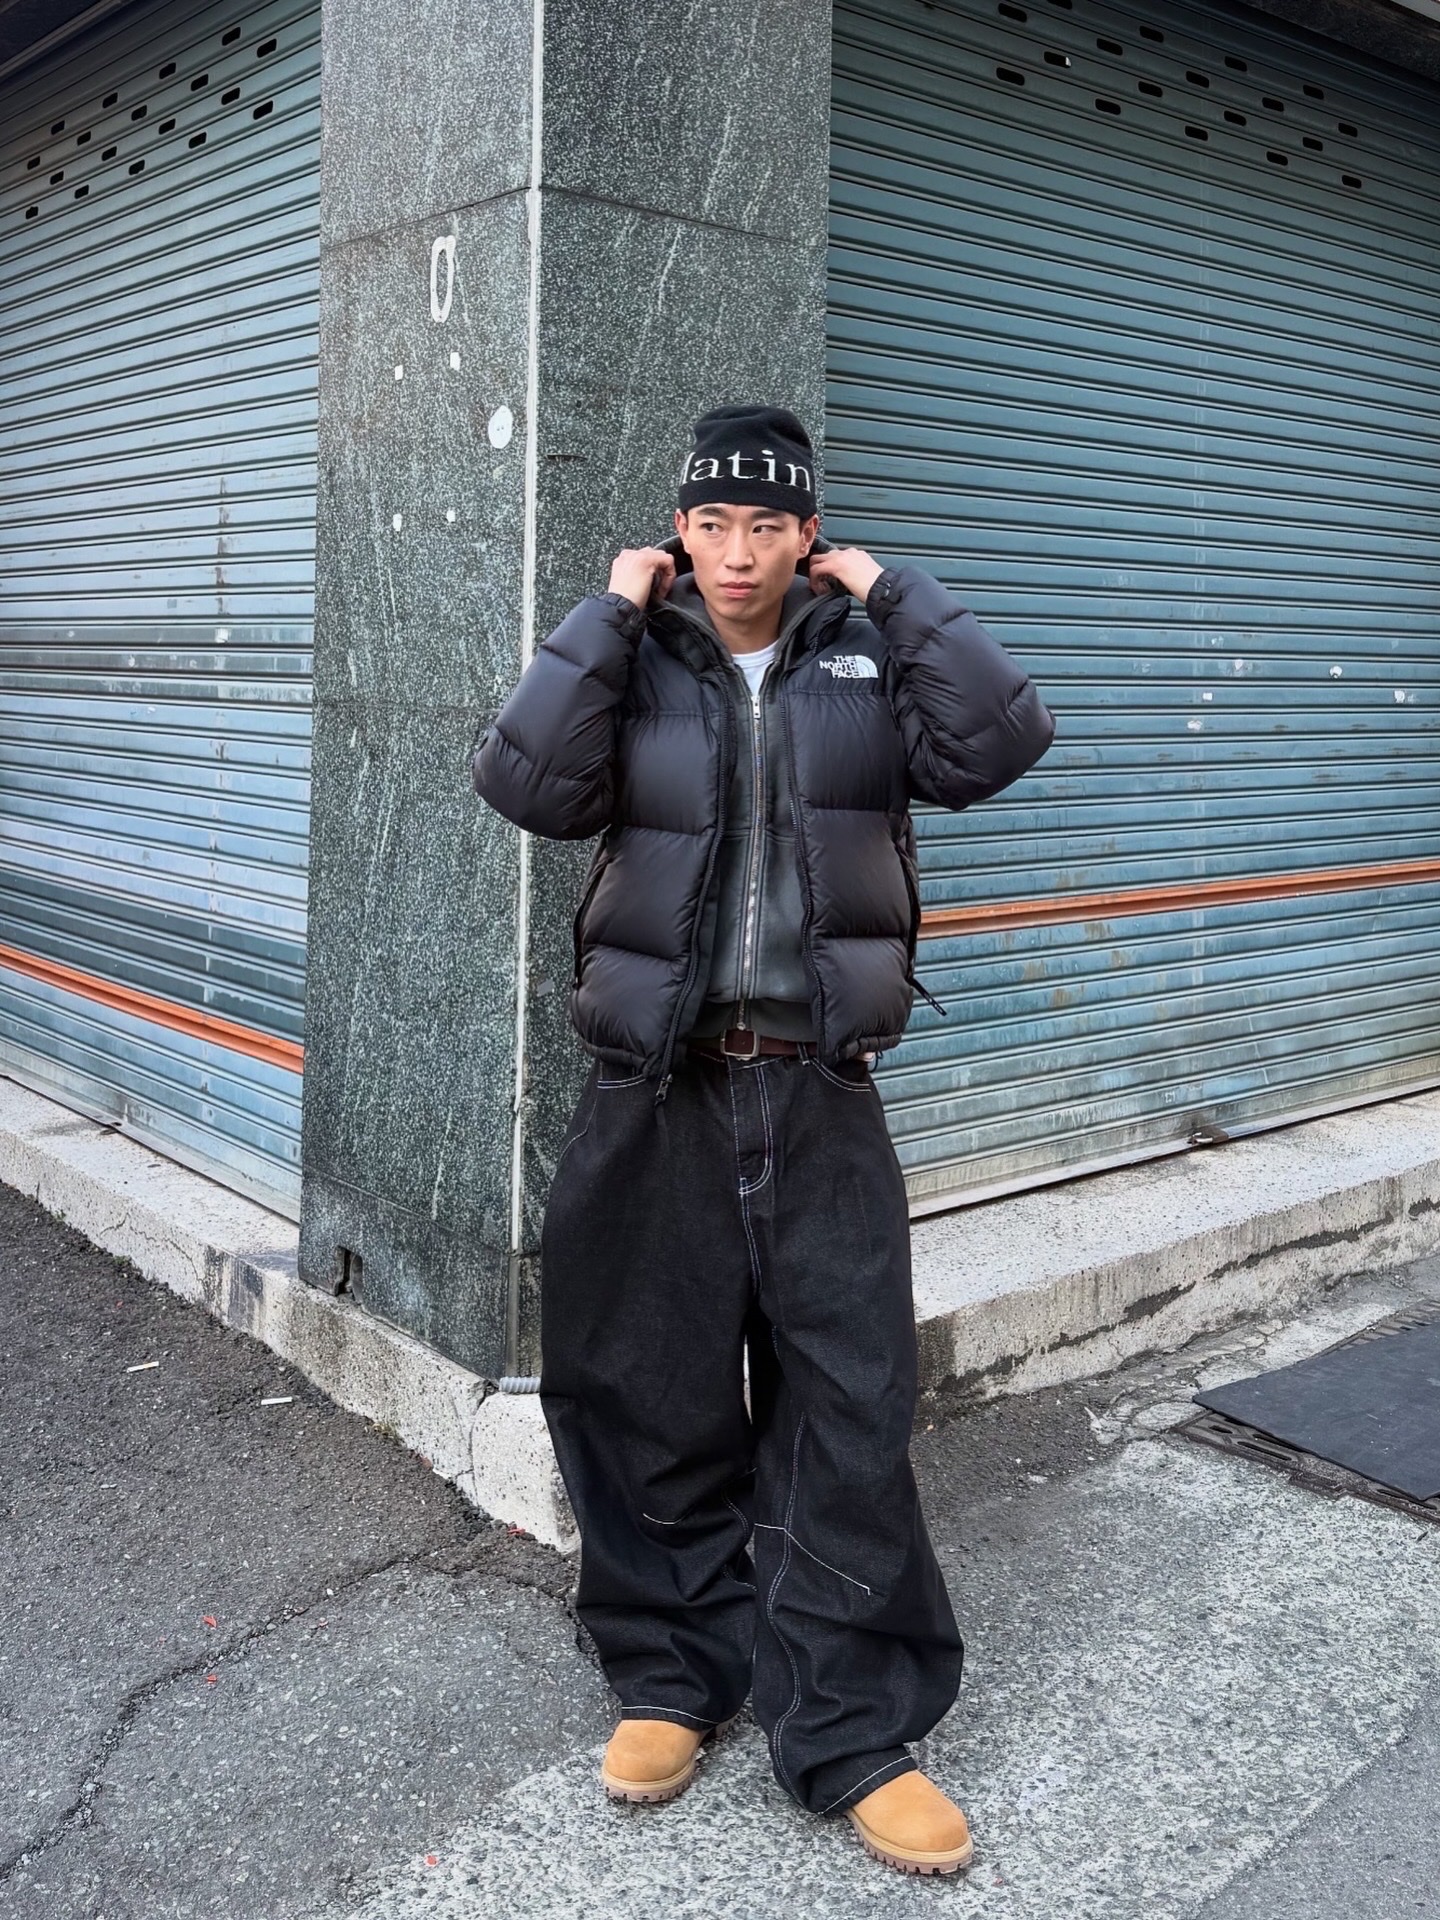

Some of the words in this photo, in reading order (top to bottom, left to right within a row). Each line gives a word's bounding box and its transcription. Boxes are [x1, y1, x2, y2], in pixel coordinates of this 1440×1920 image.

[833, 655, 855, 663] THE
[819, 660, 856, 671] NORTH
[832, 669, 860, 678] FACE
